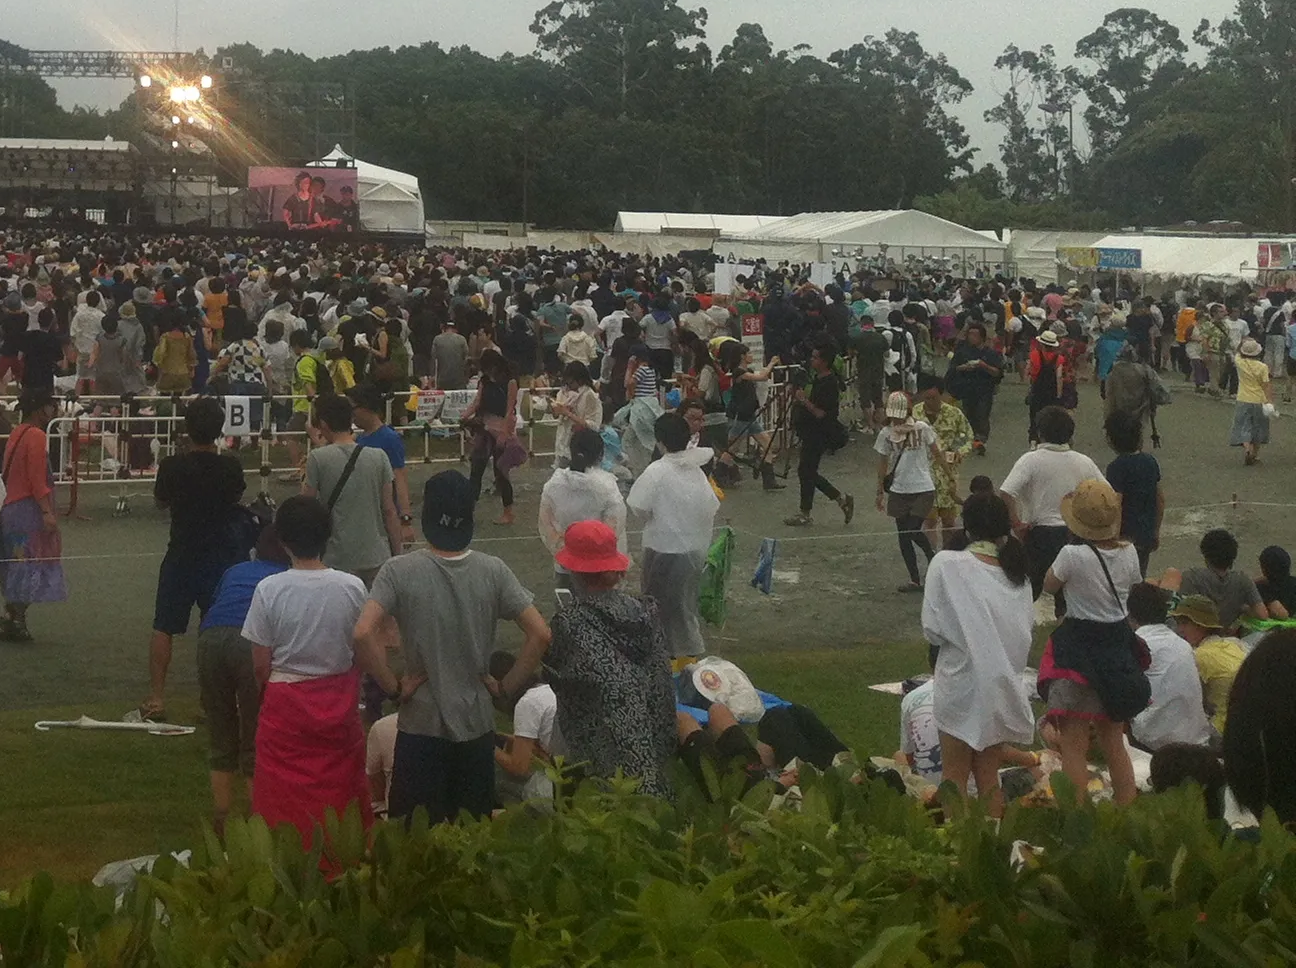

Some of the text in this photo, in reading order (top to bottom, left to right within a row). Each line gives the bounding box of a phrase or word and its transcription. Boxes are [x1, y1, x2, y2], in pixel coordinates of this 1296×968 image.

[840, 262, 851, 275] A
[230, 404, 245, 426] B
[439, 513, 464, 529] NY
